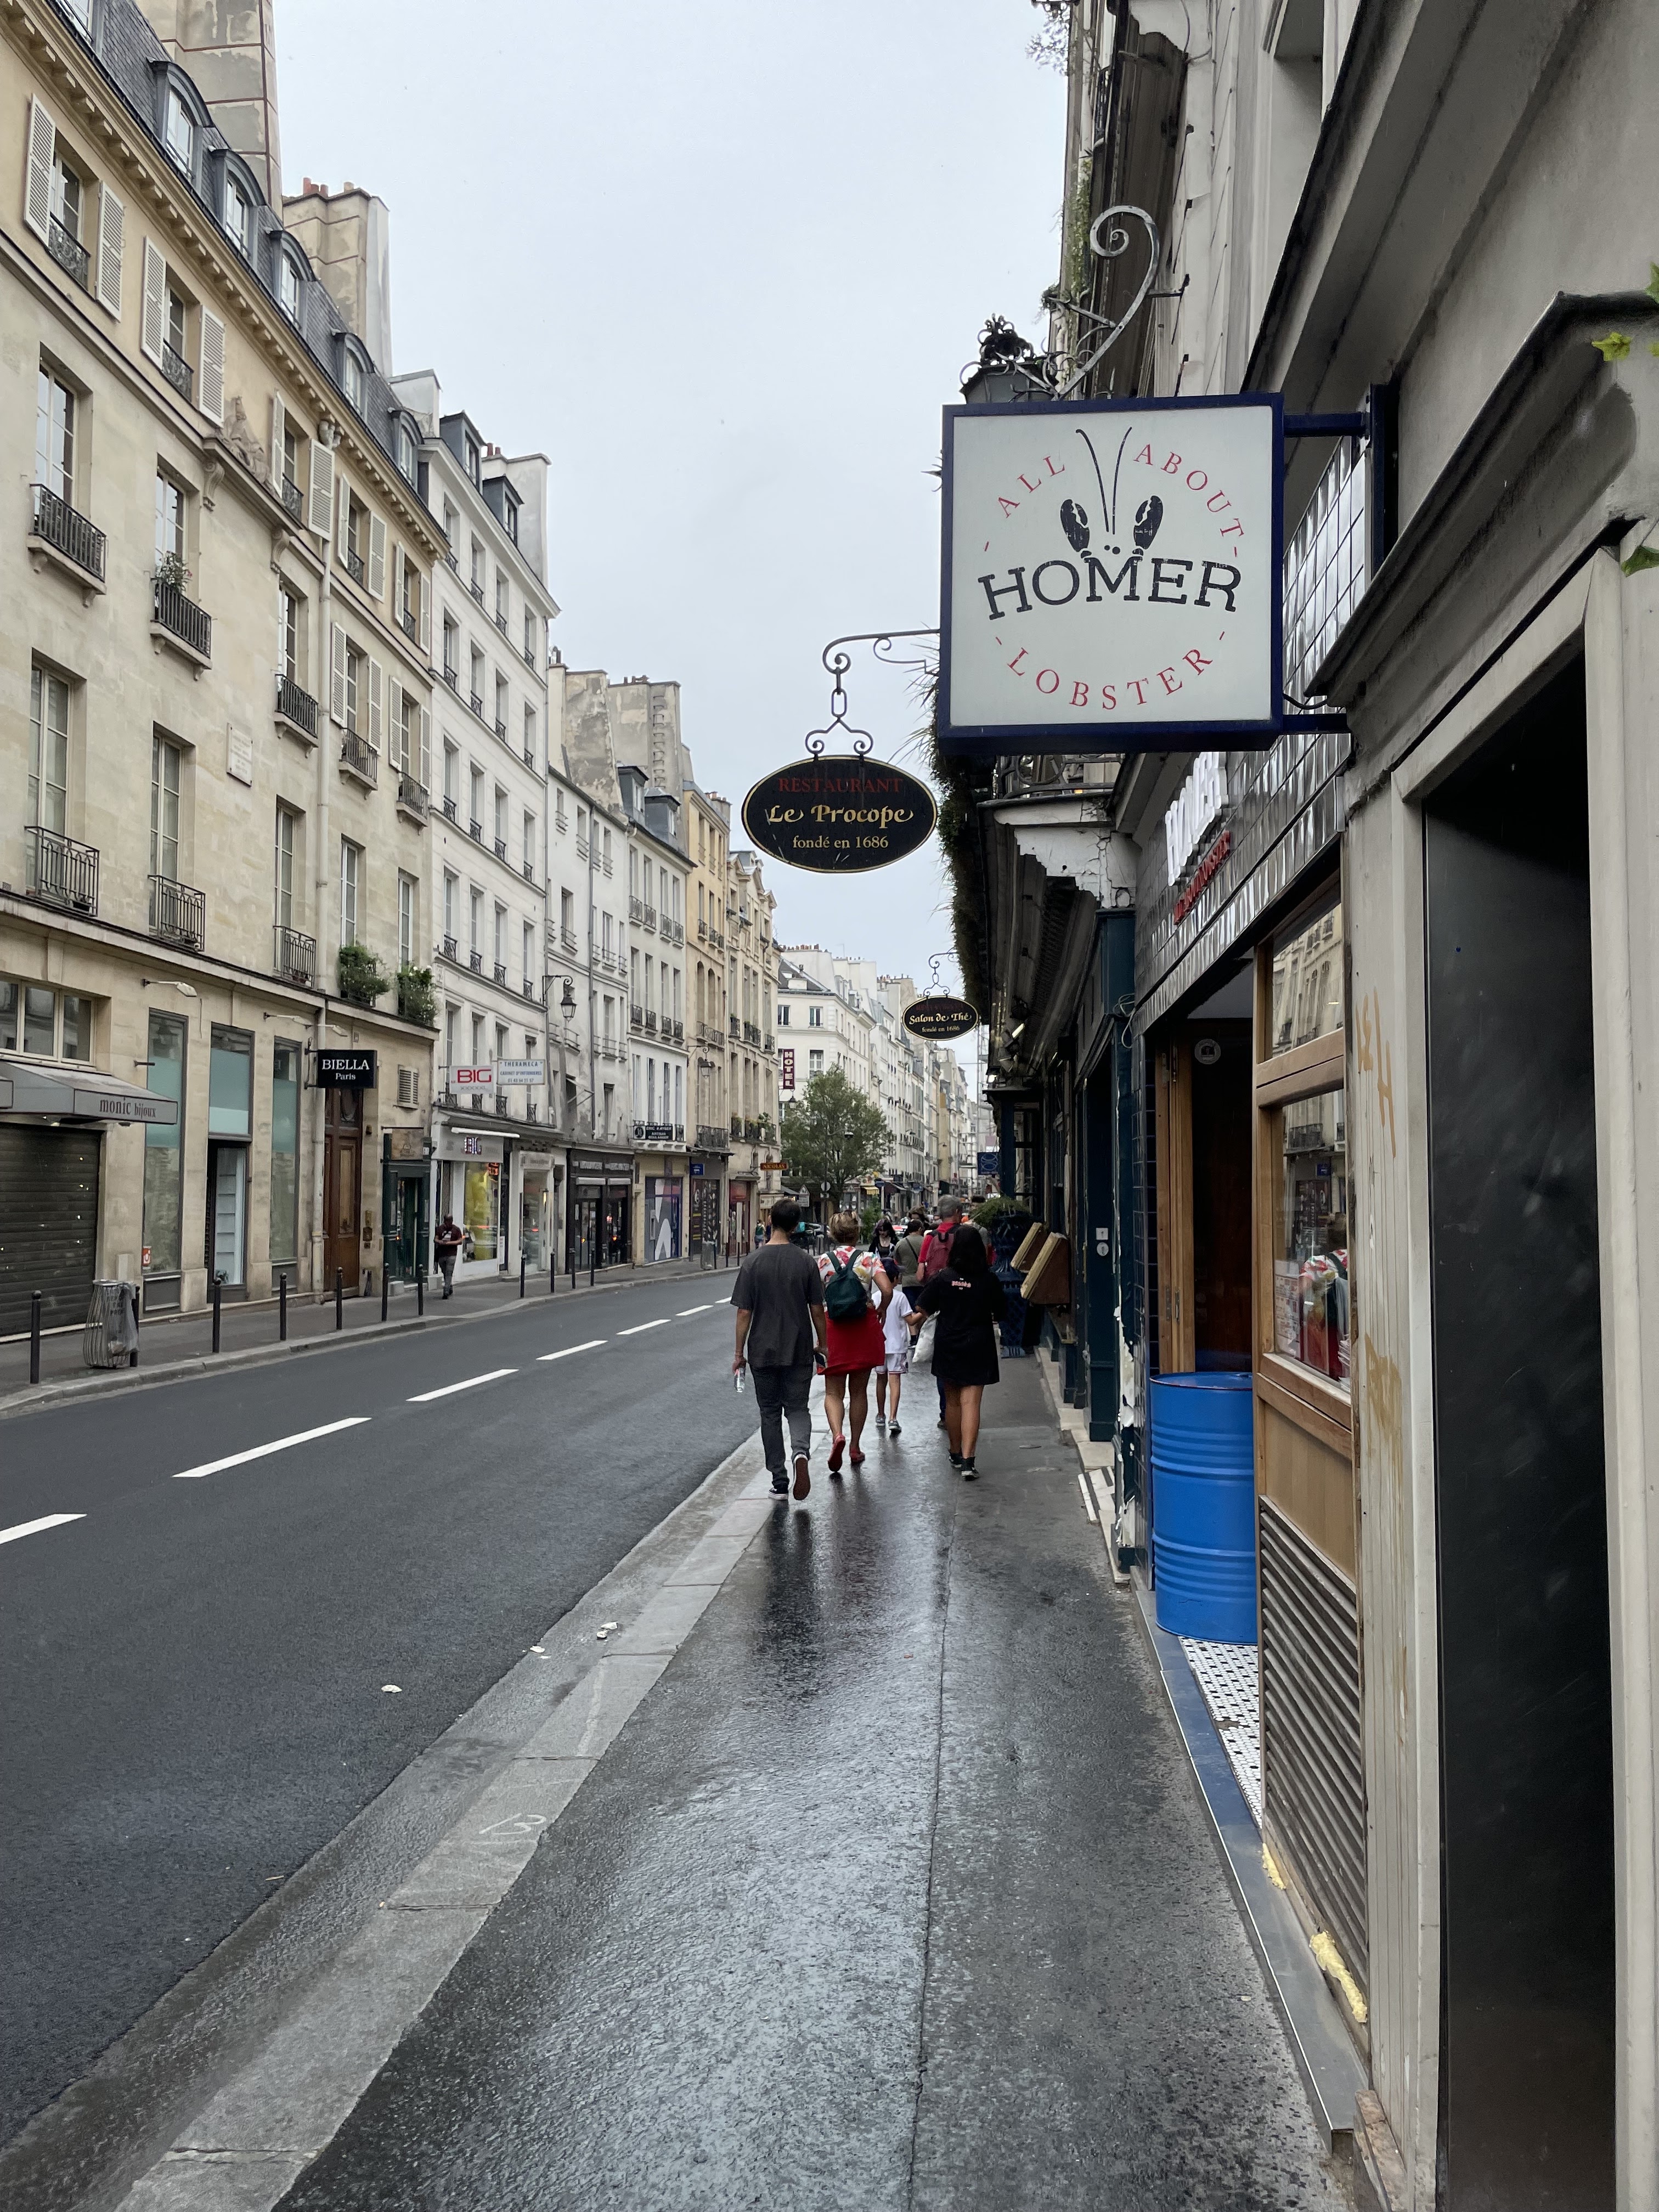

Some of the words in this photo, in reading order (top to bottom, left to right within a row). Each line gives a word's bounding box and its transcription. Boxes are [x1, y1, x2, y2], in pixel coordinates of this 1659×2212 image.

[997, 455, 1065, 518] ALL
[1133, 443, 1244, 539] ABOUT
[978, 555, 1242, 620] HOMER
[1007, 647, 1213, 710] LOBSTER
[778, 778, 903, 793] RESTAURANT
[769, 804, 804, 823] Le
[810, 804, 914, 829] Procope
[793, 835, 830, 849] fondé
[834, 839, 850, 849] en
[855, 836, 889, 849] 1686
[909, 1014, 934, 1025] Salon
[935, 1013, 950, 1022] de
[951, 1012, 972, 1021] Thé
[321, 1059, 370, 1070] BIELLA
[784, 1051, 793, 1087] HOTEL
[457, 1069, 492, 1084] BIG
[99, 1097, 131, 1115] monic
[134, 1103, 156, 1119] bijoux
